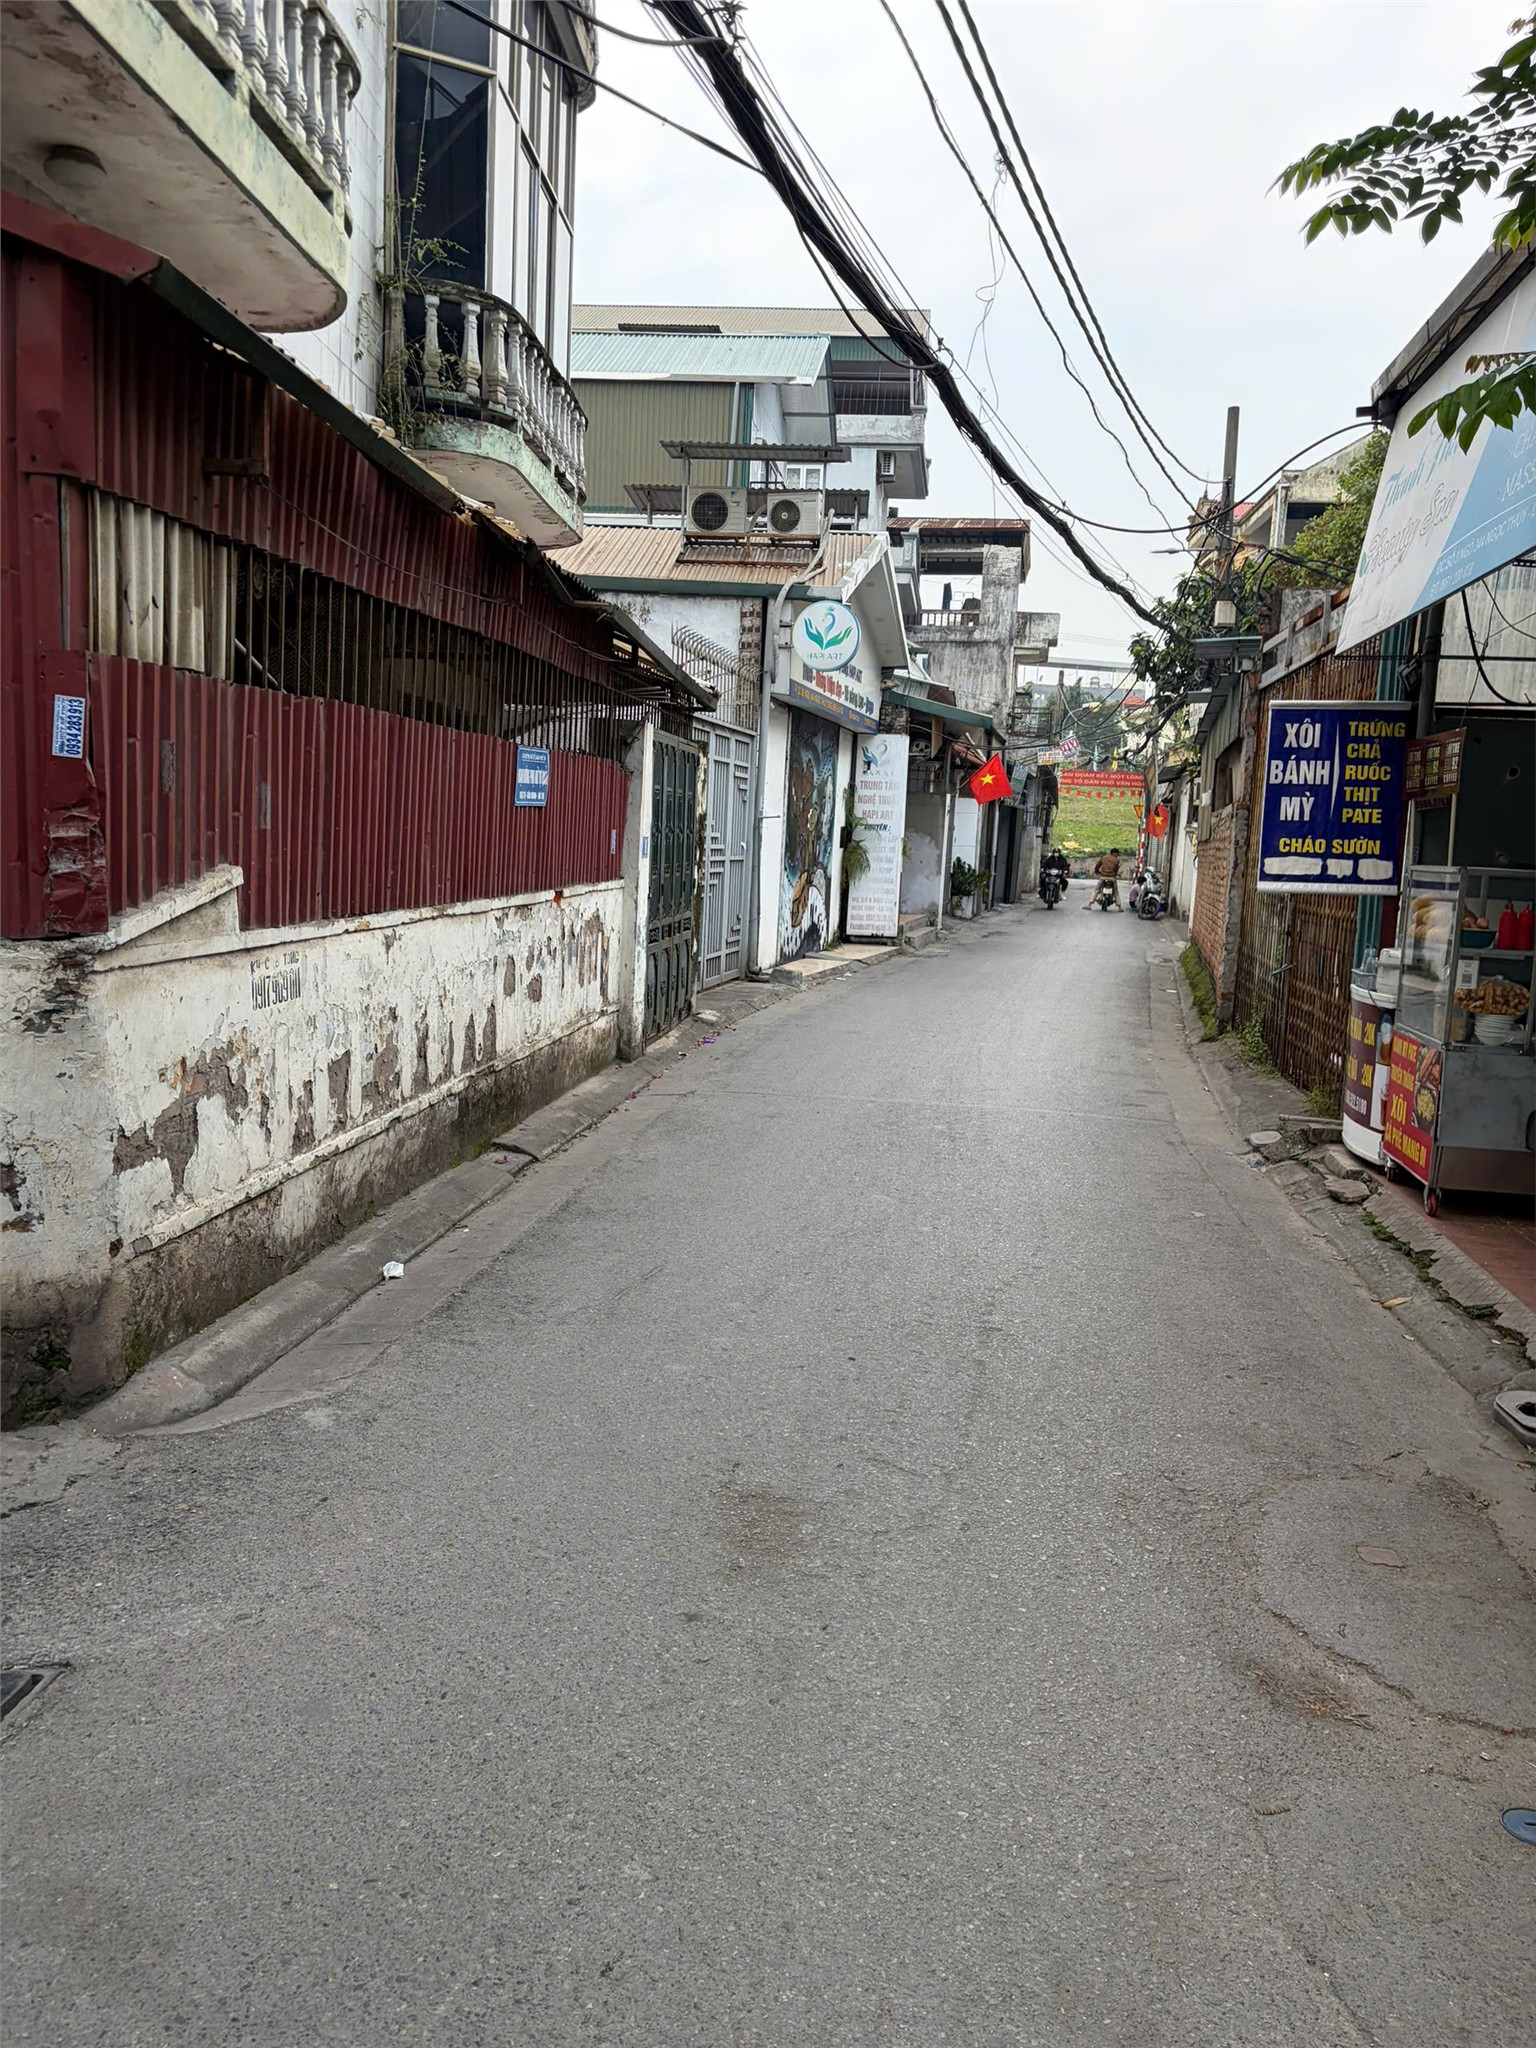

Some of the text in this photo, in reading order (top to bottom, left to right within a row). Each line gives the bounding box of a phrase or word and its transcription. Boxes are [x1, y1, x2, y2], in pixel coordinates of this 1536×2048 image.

[806, 652, 843, 661] HAPI ART
[1283, 717, 1406, 748] XÔI TRỨNG
[1346, 739, 1381, 759] CHẢ
[1269, 755, 1391, 785] BÁNH RUỐC
[859, 779, 883, 791] TRUNG
[857, 793, 877, 807] NGHỆ
[1279, 786, 1381, 821] MỲ THỊT
[1341, 808, 1382, 824] PATE
[1279, 835, 1381, 855] CHÁO SƯỜN
[1390, 1093, 1407, 1126] XÔI
[1402, 1132, 1420, 1163] MANG
